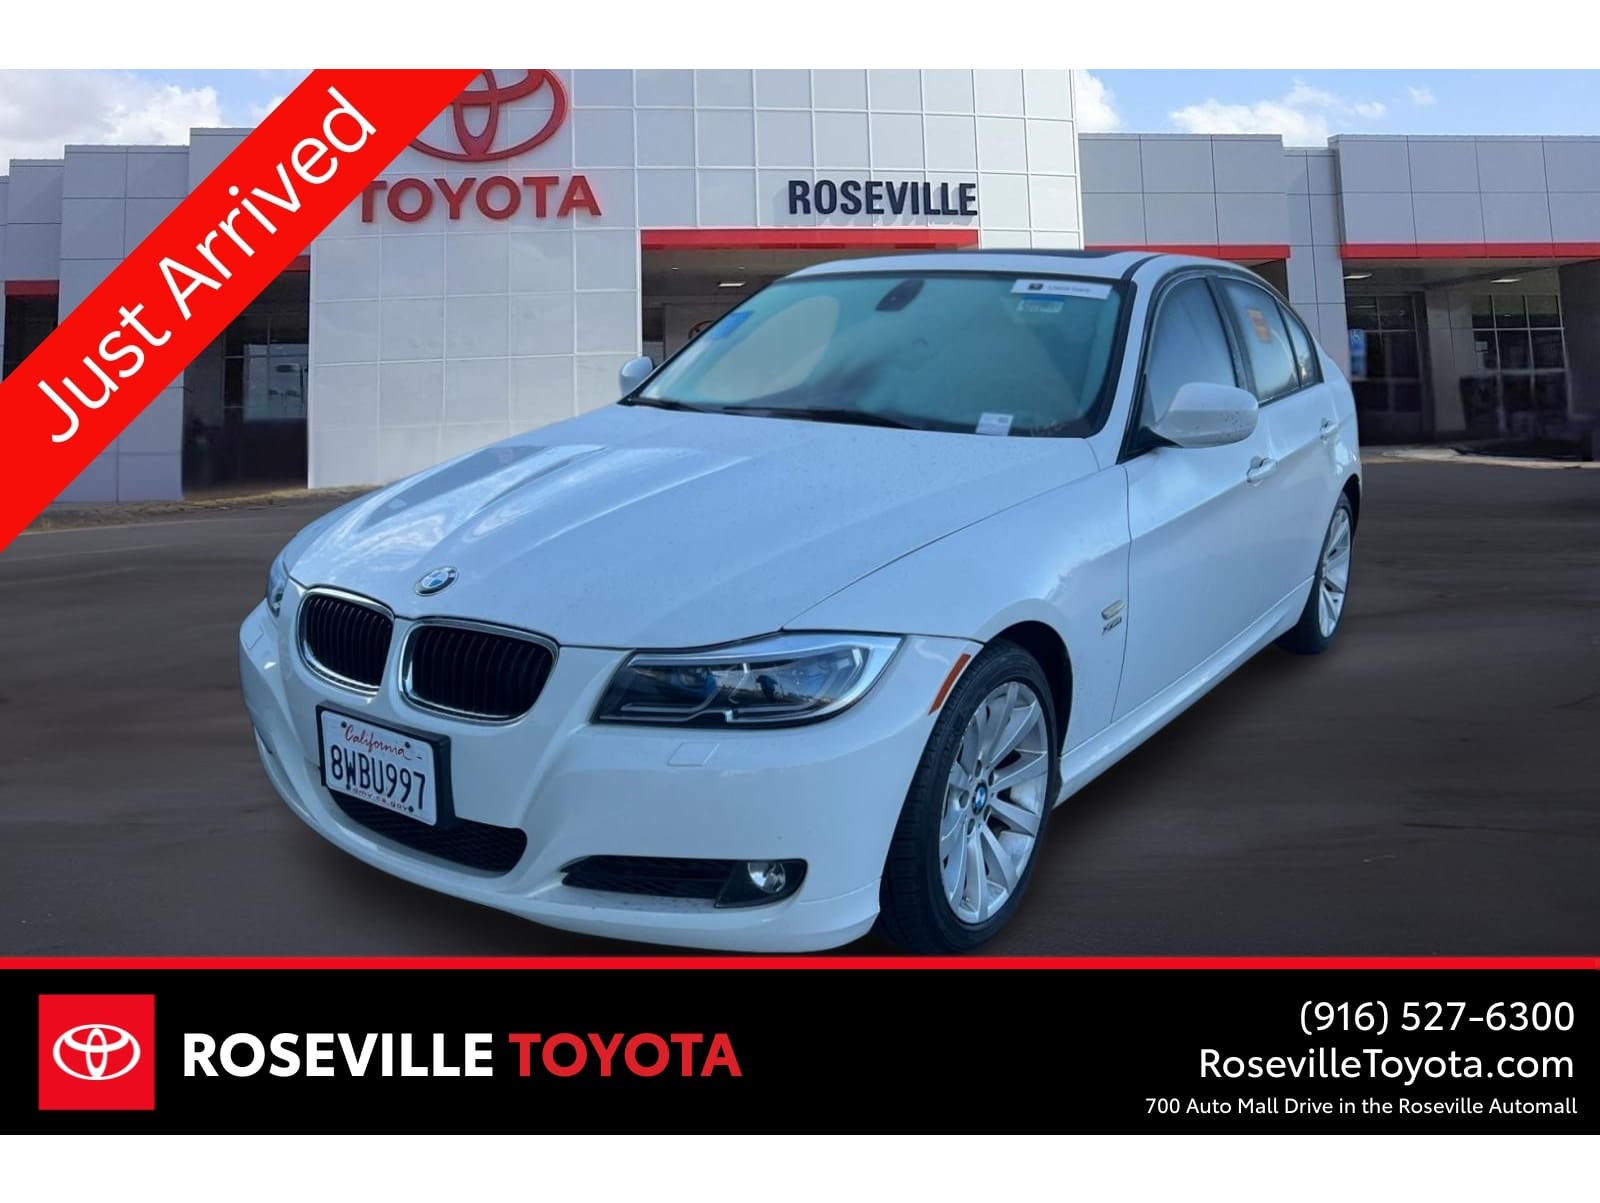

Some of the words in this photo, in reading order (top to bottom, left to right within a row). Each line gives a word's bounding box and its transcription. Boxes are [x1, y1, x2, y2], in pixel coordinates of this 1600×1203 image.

[361, 175, 602, 223] TOYOTA
[788, 180, 978, 216] ROSEVILLE
[344, 723, 411, 760] California
[330, 744, 426, 811] 8WBU997
